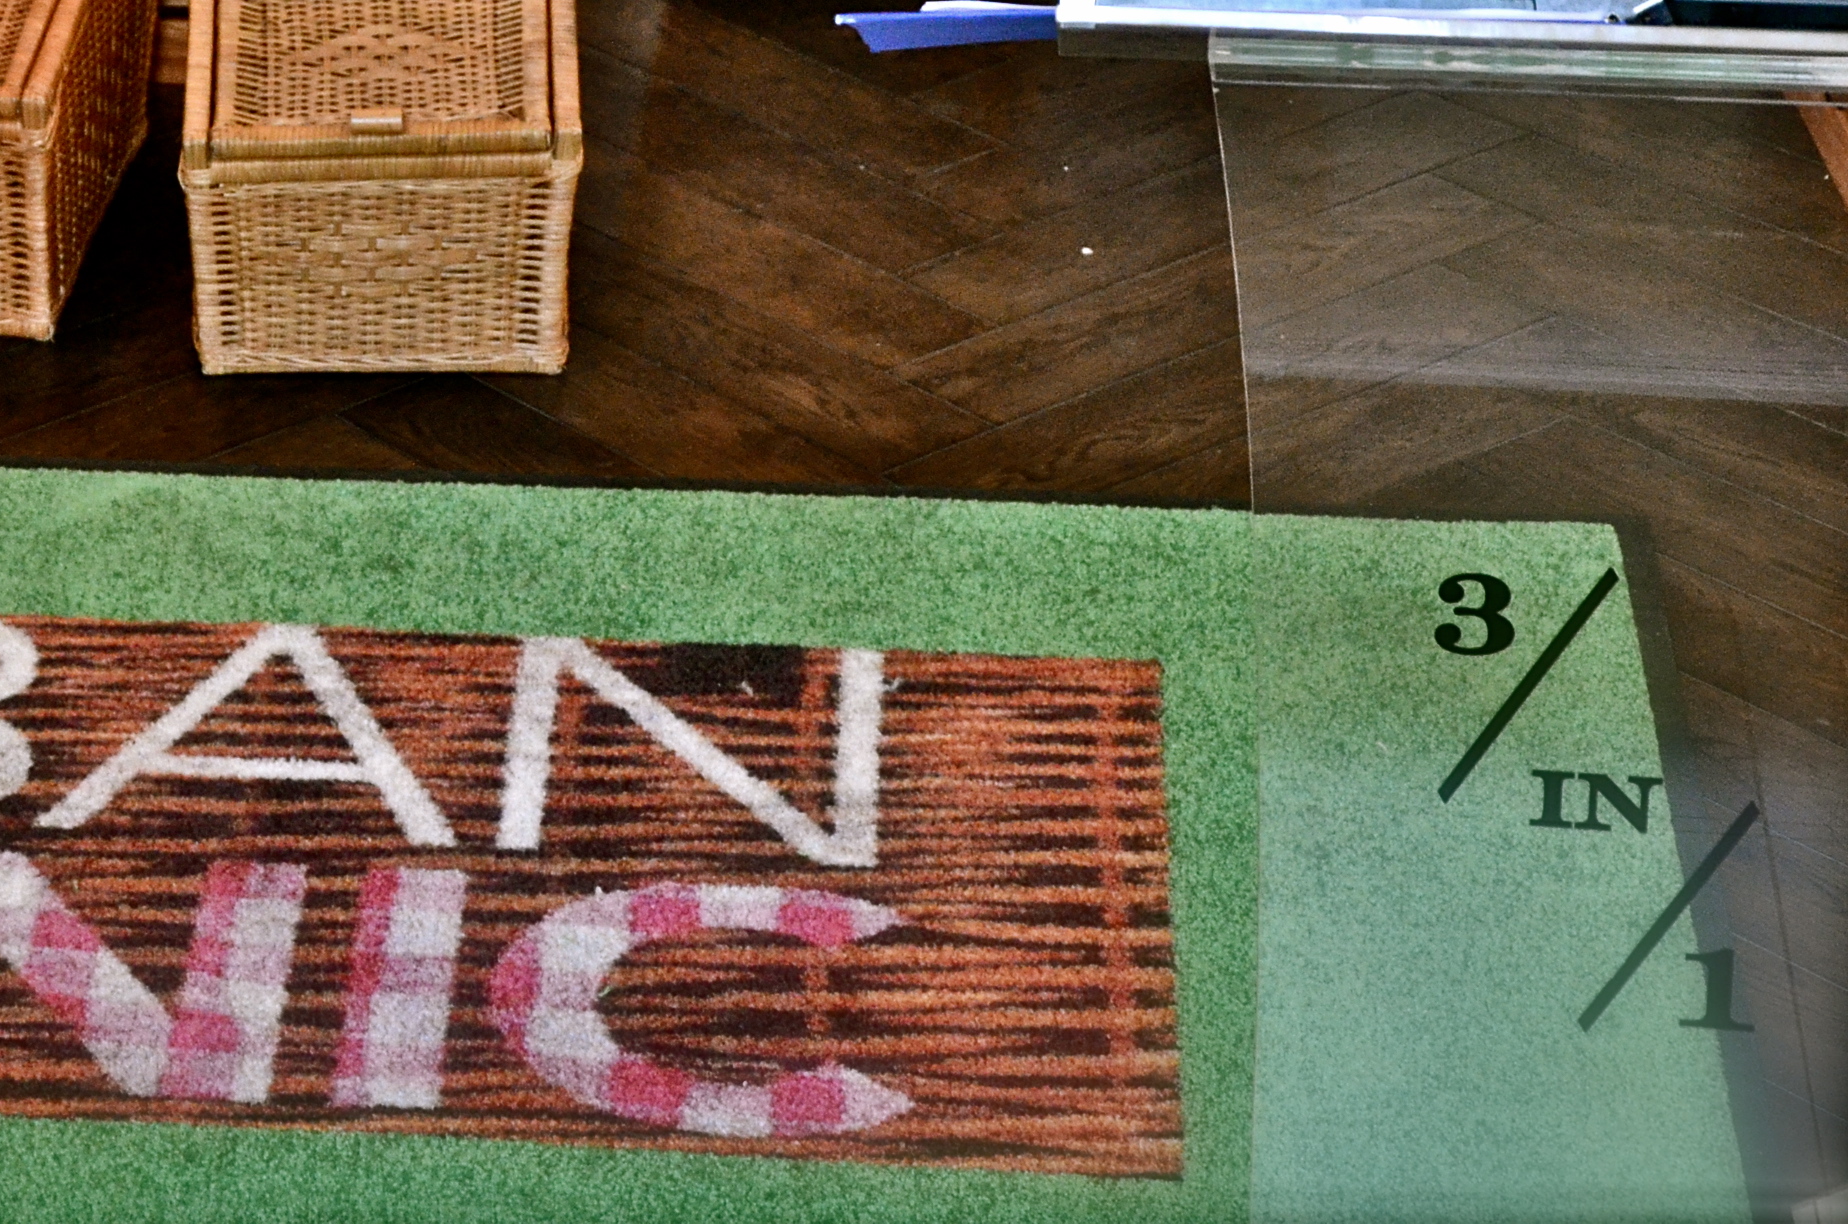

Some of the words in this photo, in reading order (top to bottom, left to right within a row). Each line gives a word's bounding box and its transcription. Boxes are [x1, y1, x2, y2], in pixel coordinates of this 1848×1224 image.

[1434, 572, 1516, 656] 3
[1528, 769, 1664, 835] IN
[1679, 948, 1756, 1033] 1
